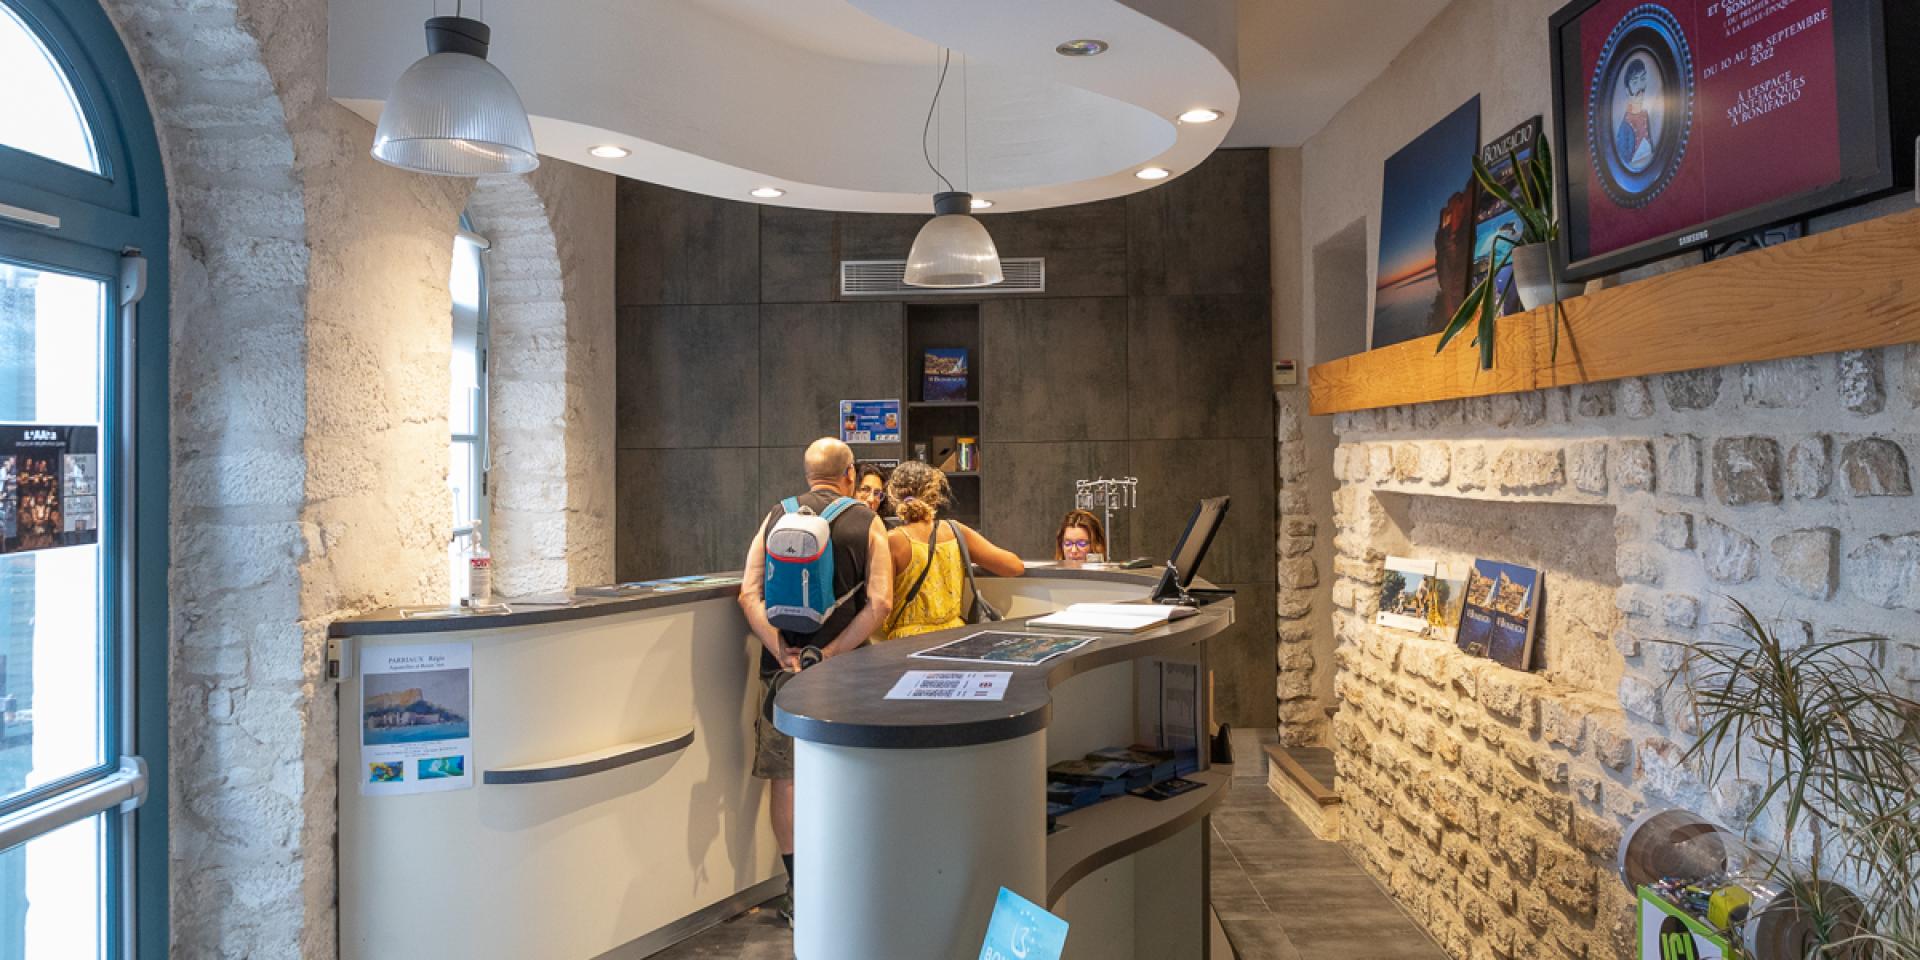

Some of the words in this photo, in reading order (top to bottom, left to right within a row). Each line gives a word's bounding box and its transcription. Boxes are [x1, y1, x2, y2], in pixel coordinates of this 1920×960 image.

[1703, 63, 1718, 79] DU
[1734, 48, 1748, 64] AU
[1766, 7, 1829, 47] SEPTEMBRE
[1747, 70, 1793, 100] L'ESPACE
[1742, 89, 1801, 122] BONIFACIO
[1679, 229, 1708, 245] SAMSUNG
